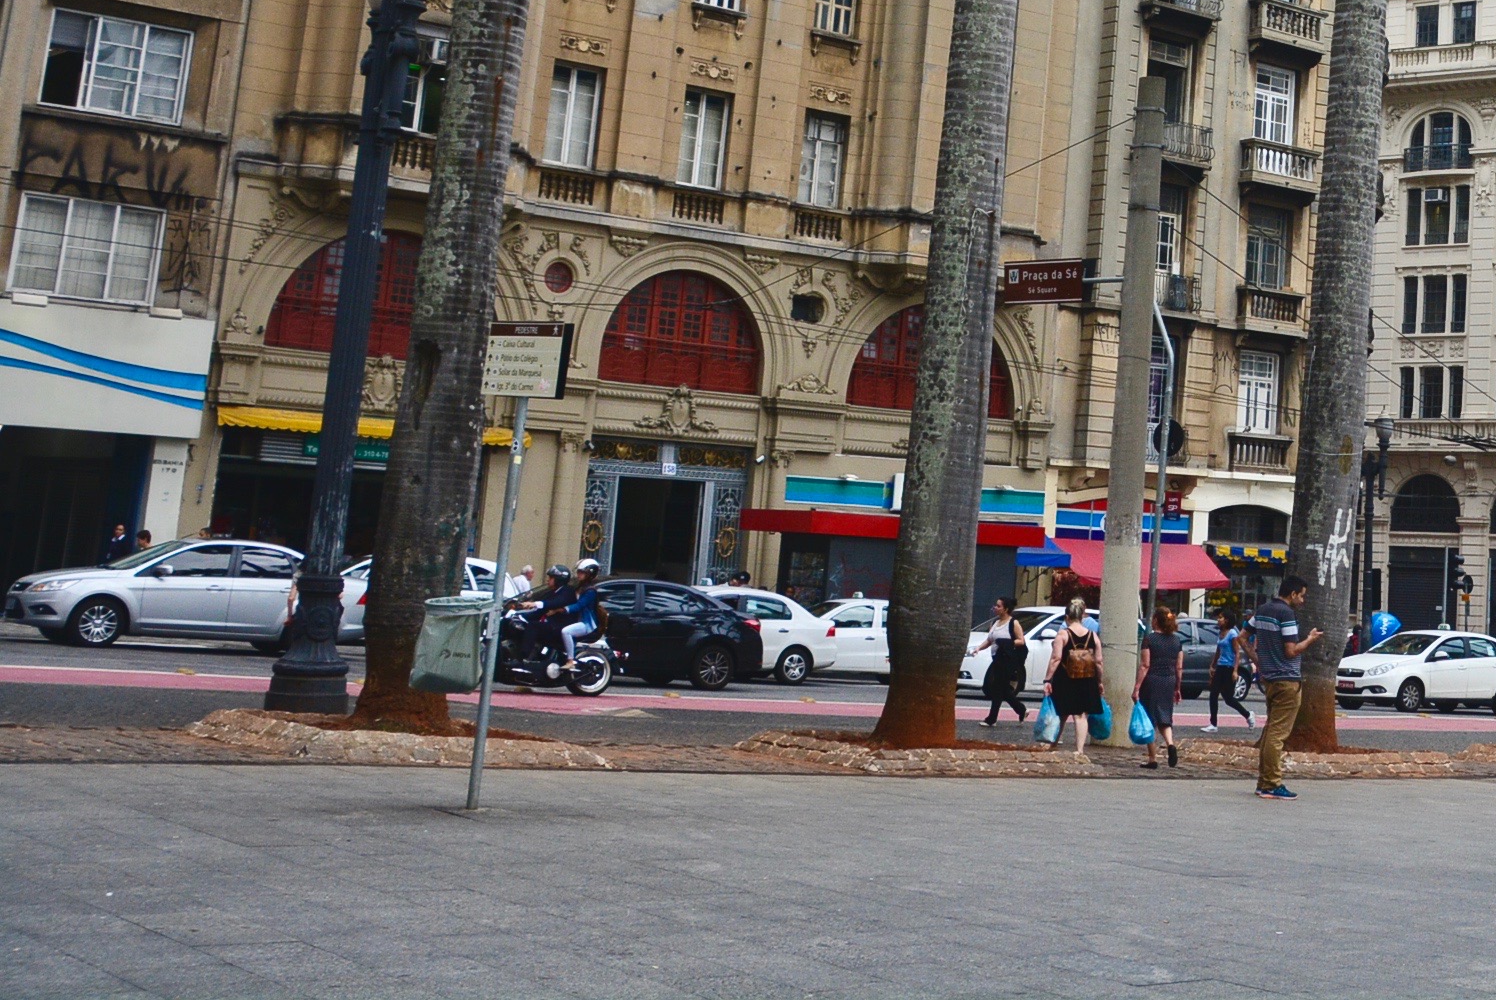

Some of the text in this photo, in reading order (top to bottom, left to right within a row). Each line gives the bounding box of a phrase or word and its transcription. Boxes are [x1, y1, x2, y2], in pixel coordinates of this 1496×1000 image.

[1022, 267, 1078, 282] Praça da Sé
[1027, 286, 1057, 294] Sé Square
[514, 326, 538, 334] PEDESTRE
[502, 339, 535, 348] Caixa Cultural
[513, 354, 519, 362] do
[498, 368, 542, 378] Solar da Marquesa
[518, 382, 534, 391] Carmo
[1380, 617, 1388, 636] vivo
